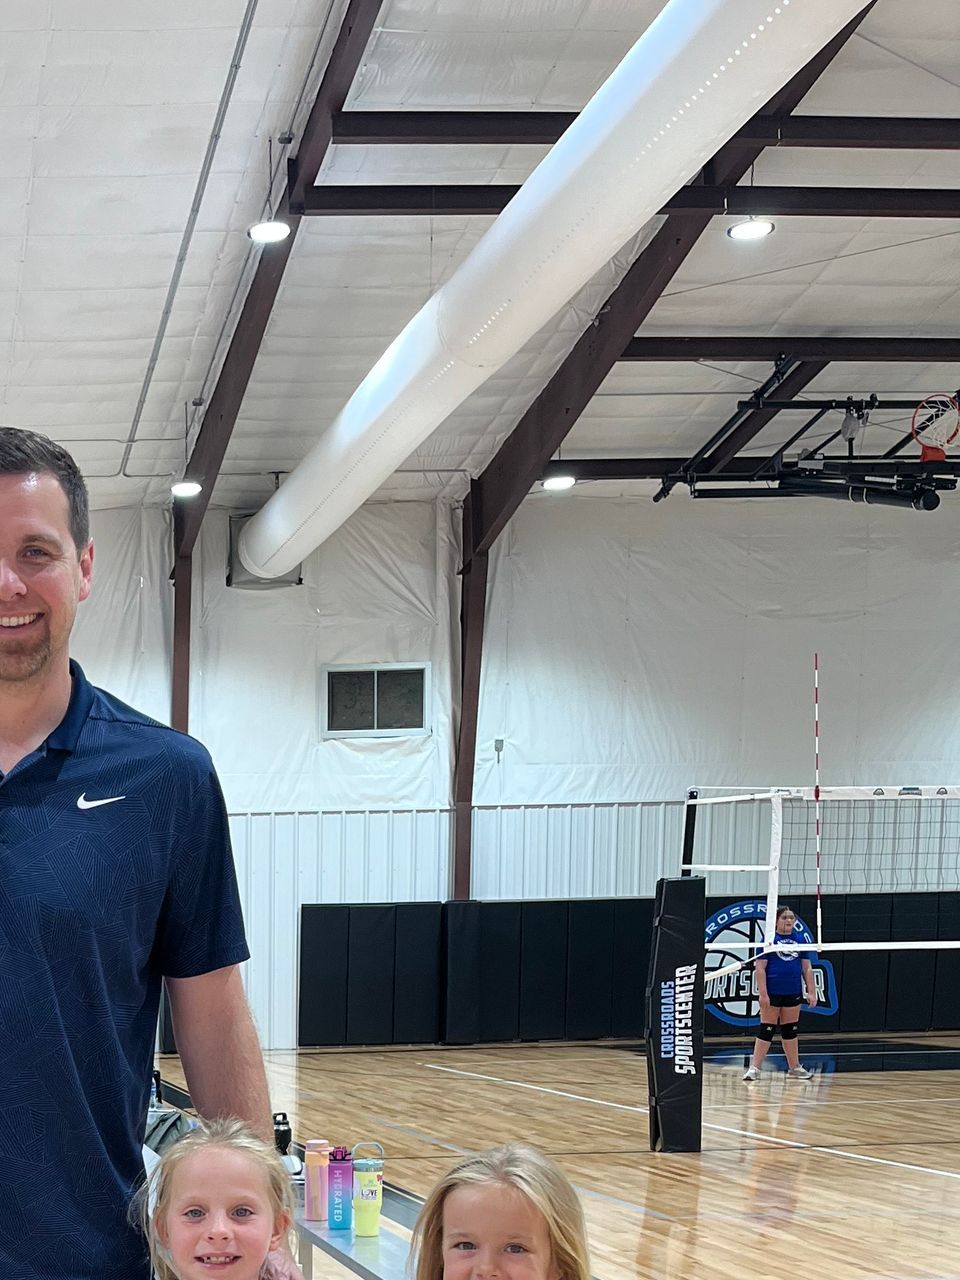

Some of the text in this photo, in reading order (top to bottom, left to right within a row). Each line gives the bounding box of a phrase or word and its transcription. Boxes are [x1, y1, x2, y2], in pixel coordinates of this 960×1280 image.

[661, 981, 675, 1059] CROSSROADS
[674, 963, 697, 1075] SPORTSCENTER
[334, 1170, 343, 1222] HYDRATED
